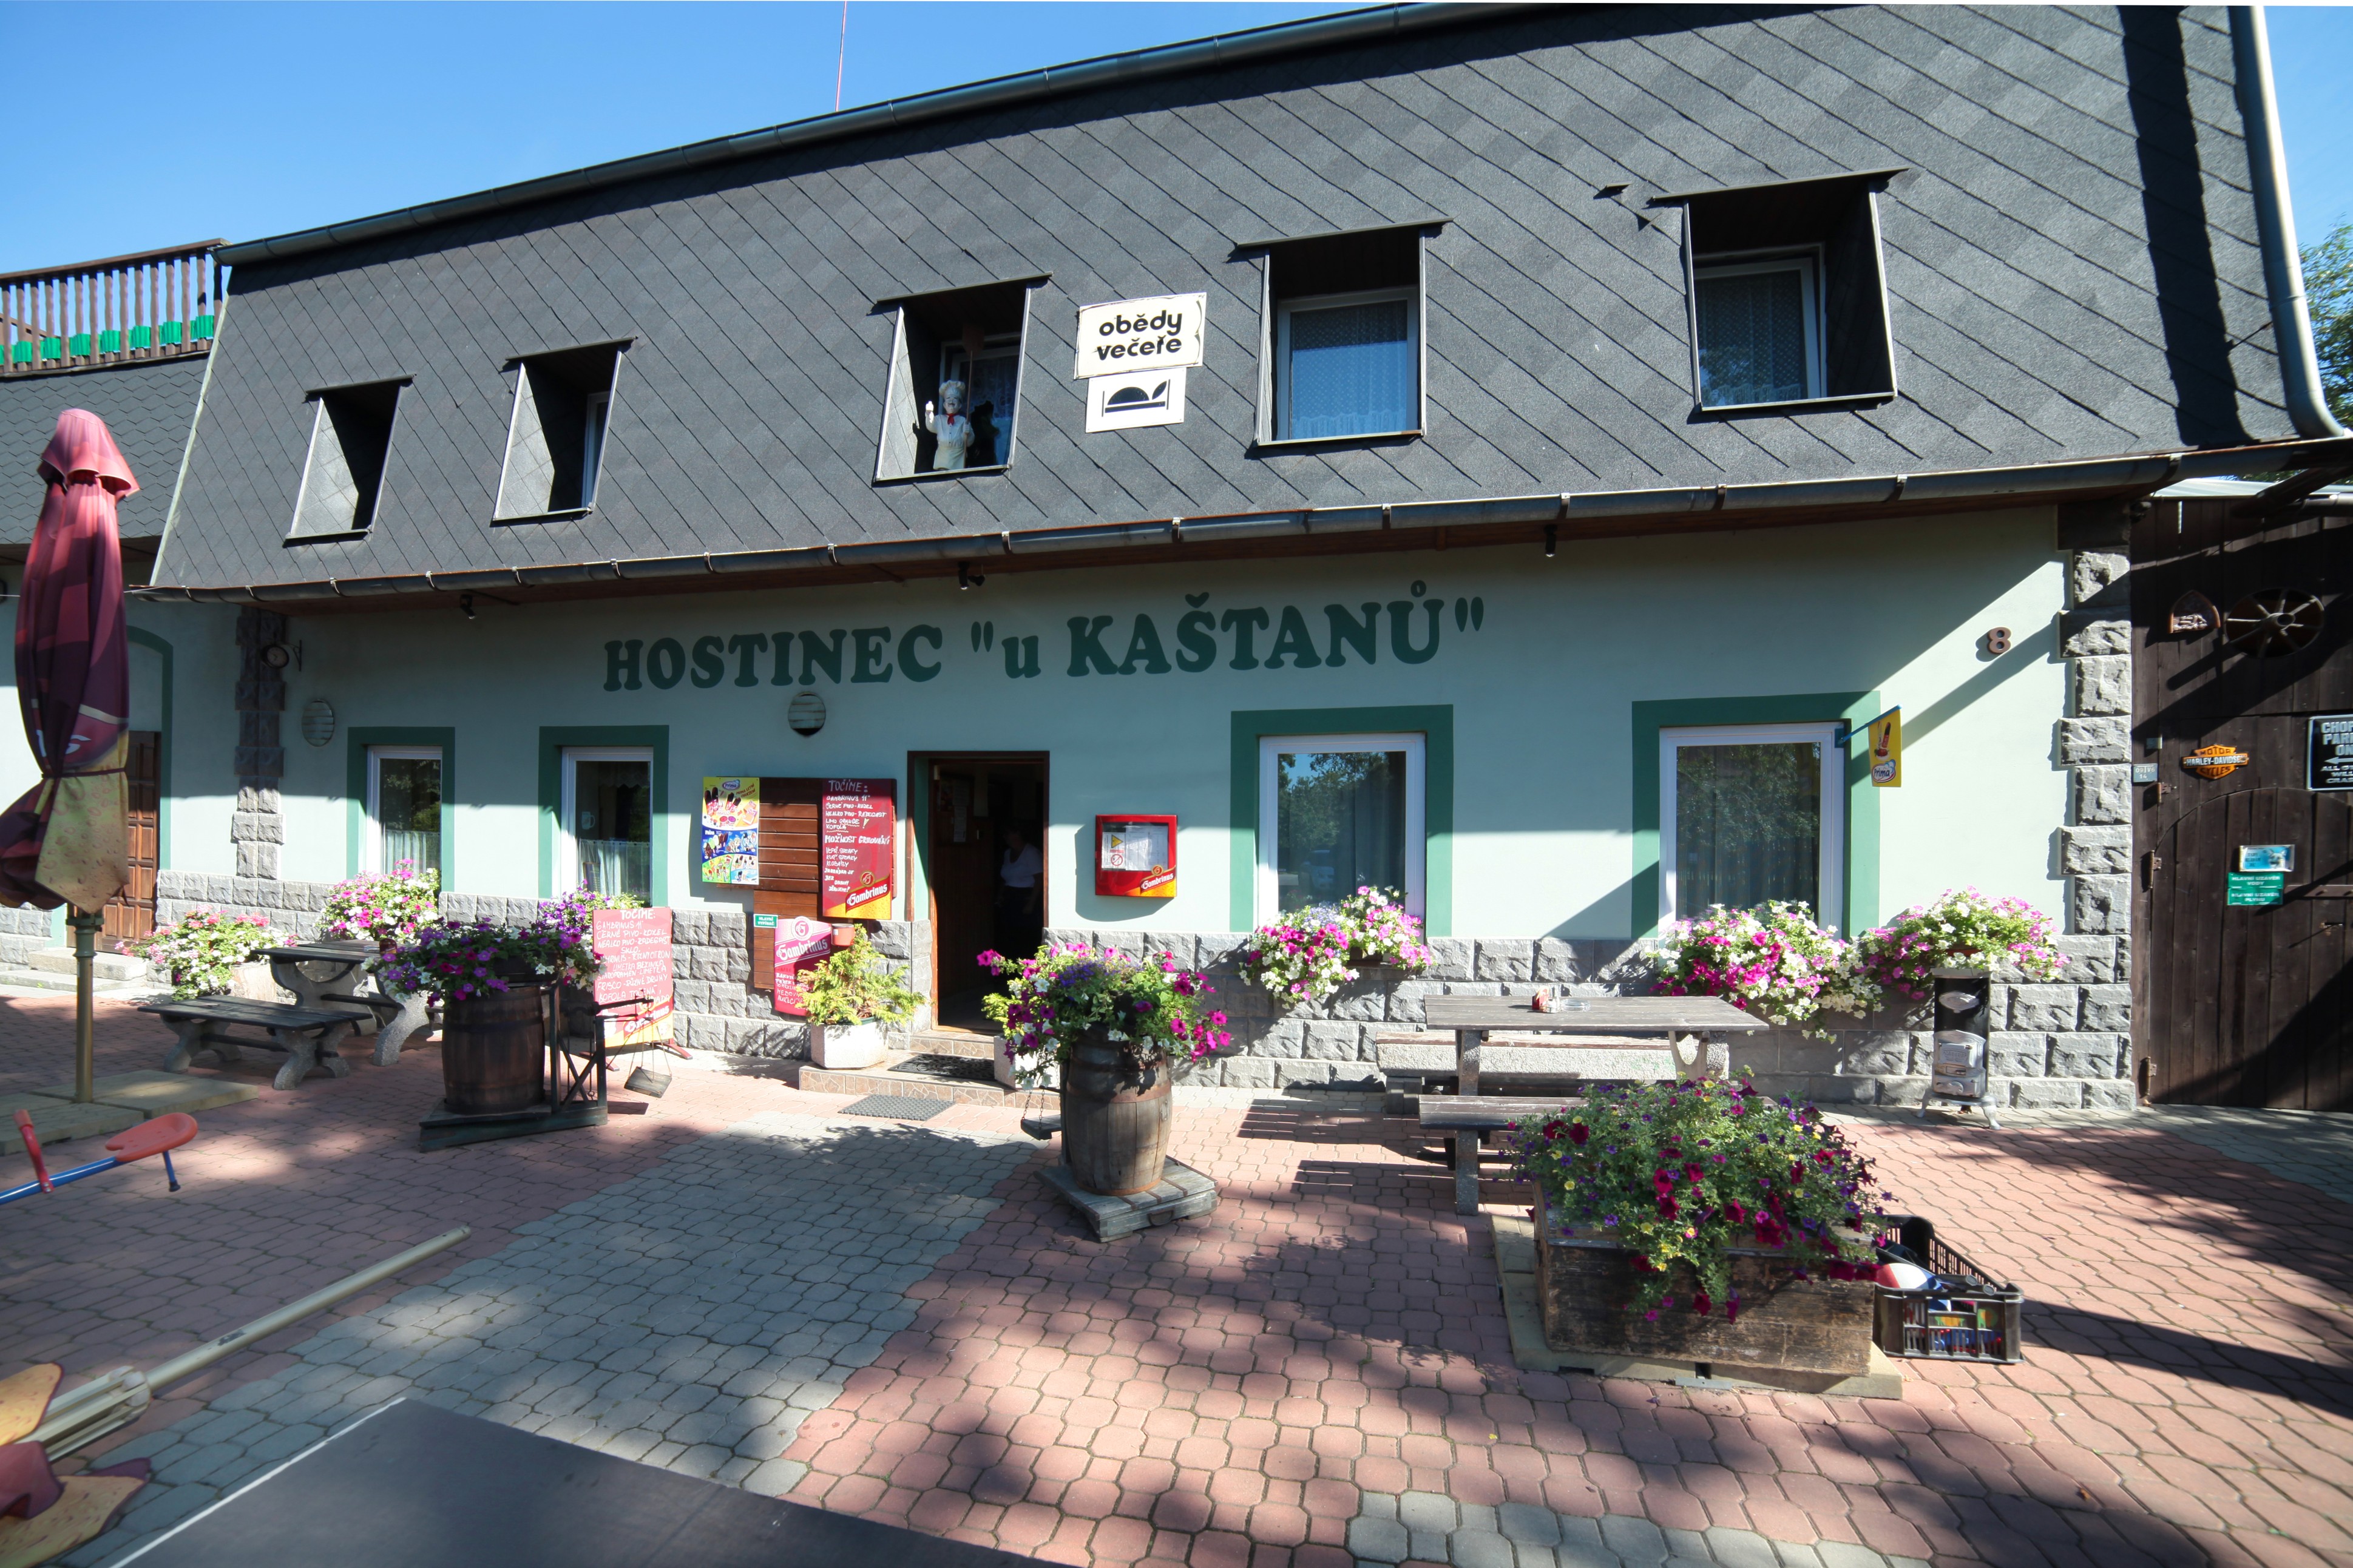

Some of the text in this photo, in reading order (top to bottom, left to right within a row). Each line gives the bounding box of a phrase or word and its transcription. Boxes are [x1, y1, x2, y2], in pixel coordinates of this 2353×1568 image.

[1099, 309, 1182, 336] obědy
[1097, 335, 1182, 360] večeře
[1988, 627, 2011, 654] 8
[603, 624, 943, 691] HOSTINEC
[2200, 746, 2231, 755] MOTOR
[1874, 768, 1890, 777] Prima
[2200, 766, 2230, 776] CYCLES
[1141, 873, 1173, 889] Gambrinus
[847, 884, 887, 905] Gambrinus
[596, 921, 634, 930] GAMBRINUS
[776, 939, 828, 961] Gambrinus
